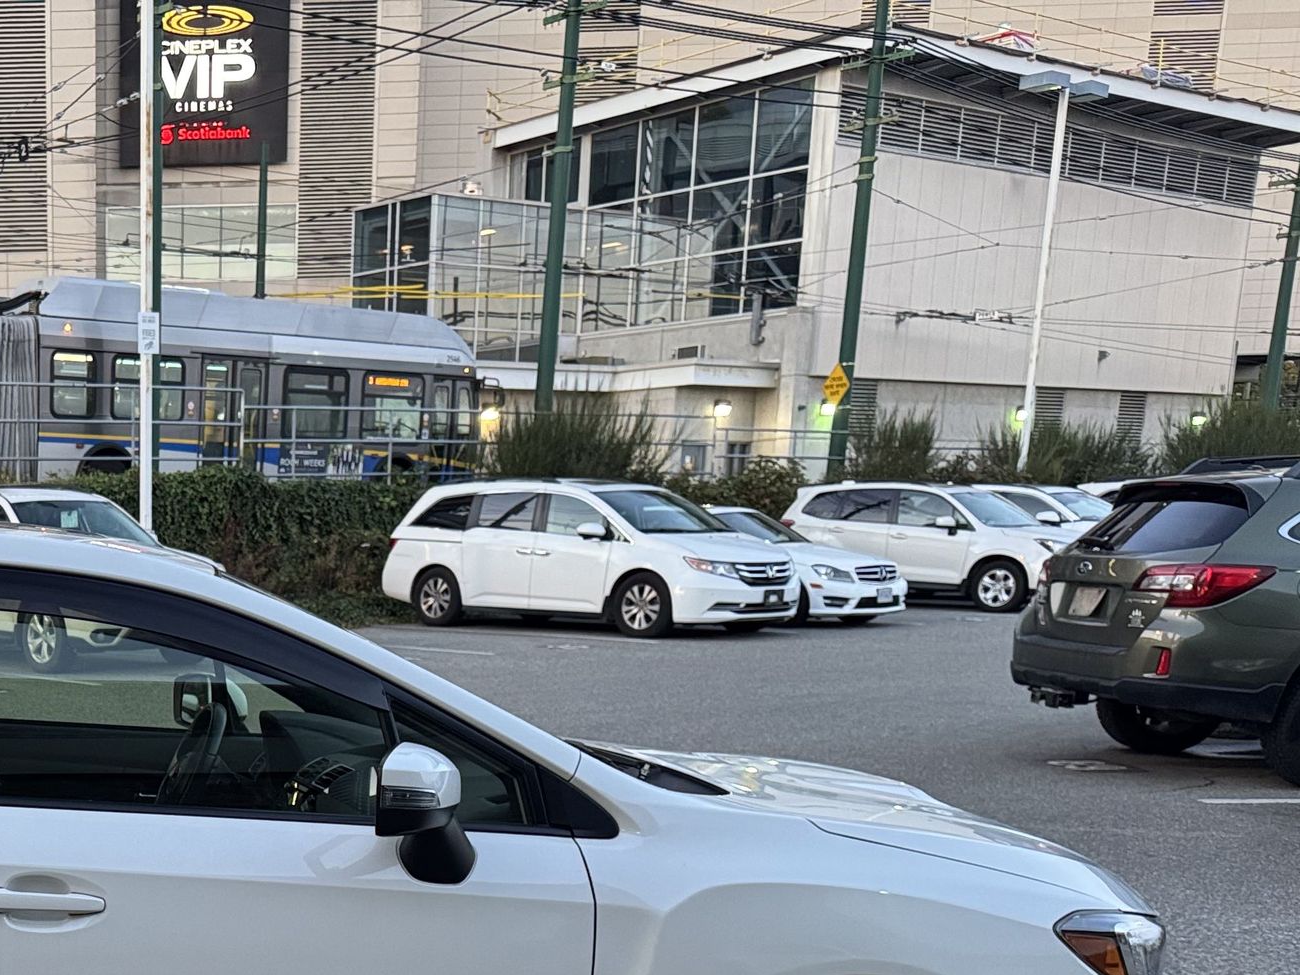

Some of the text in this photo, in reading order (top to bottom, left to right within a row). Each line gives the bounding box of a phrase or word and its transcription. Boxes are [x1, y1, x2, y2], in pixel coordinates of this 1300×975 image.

[161, 38, 253, 55] CINEPLEX
[161, 53, 256, 99] VIP
[175, 100, 233, 112] CINEMAS
[178, 126, 251, 140] Scotiabank
